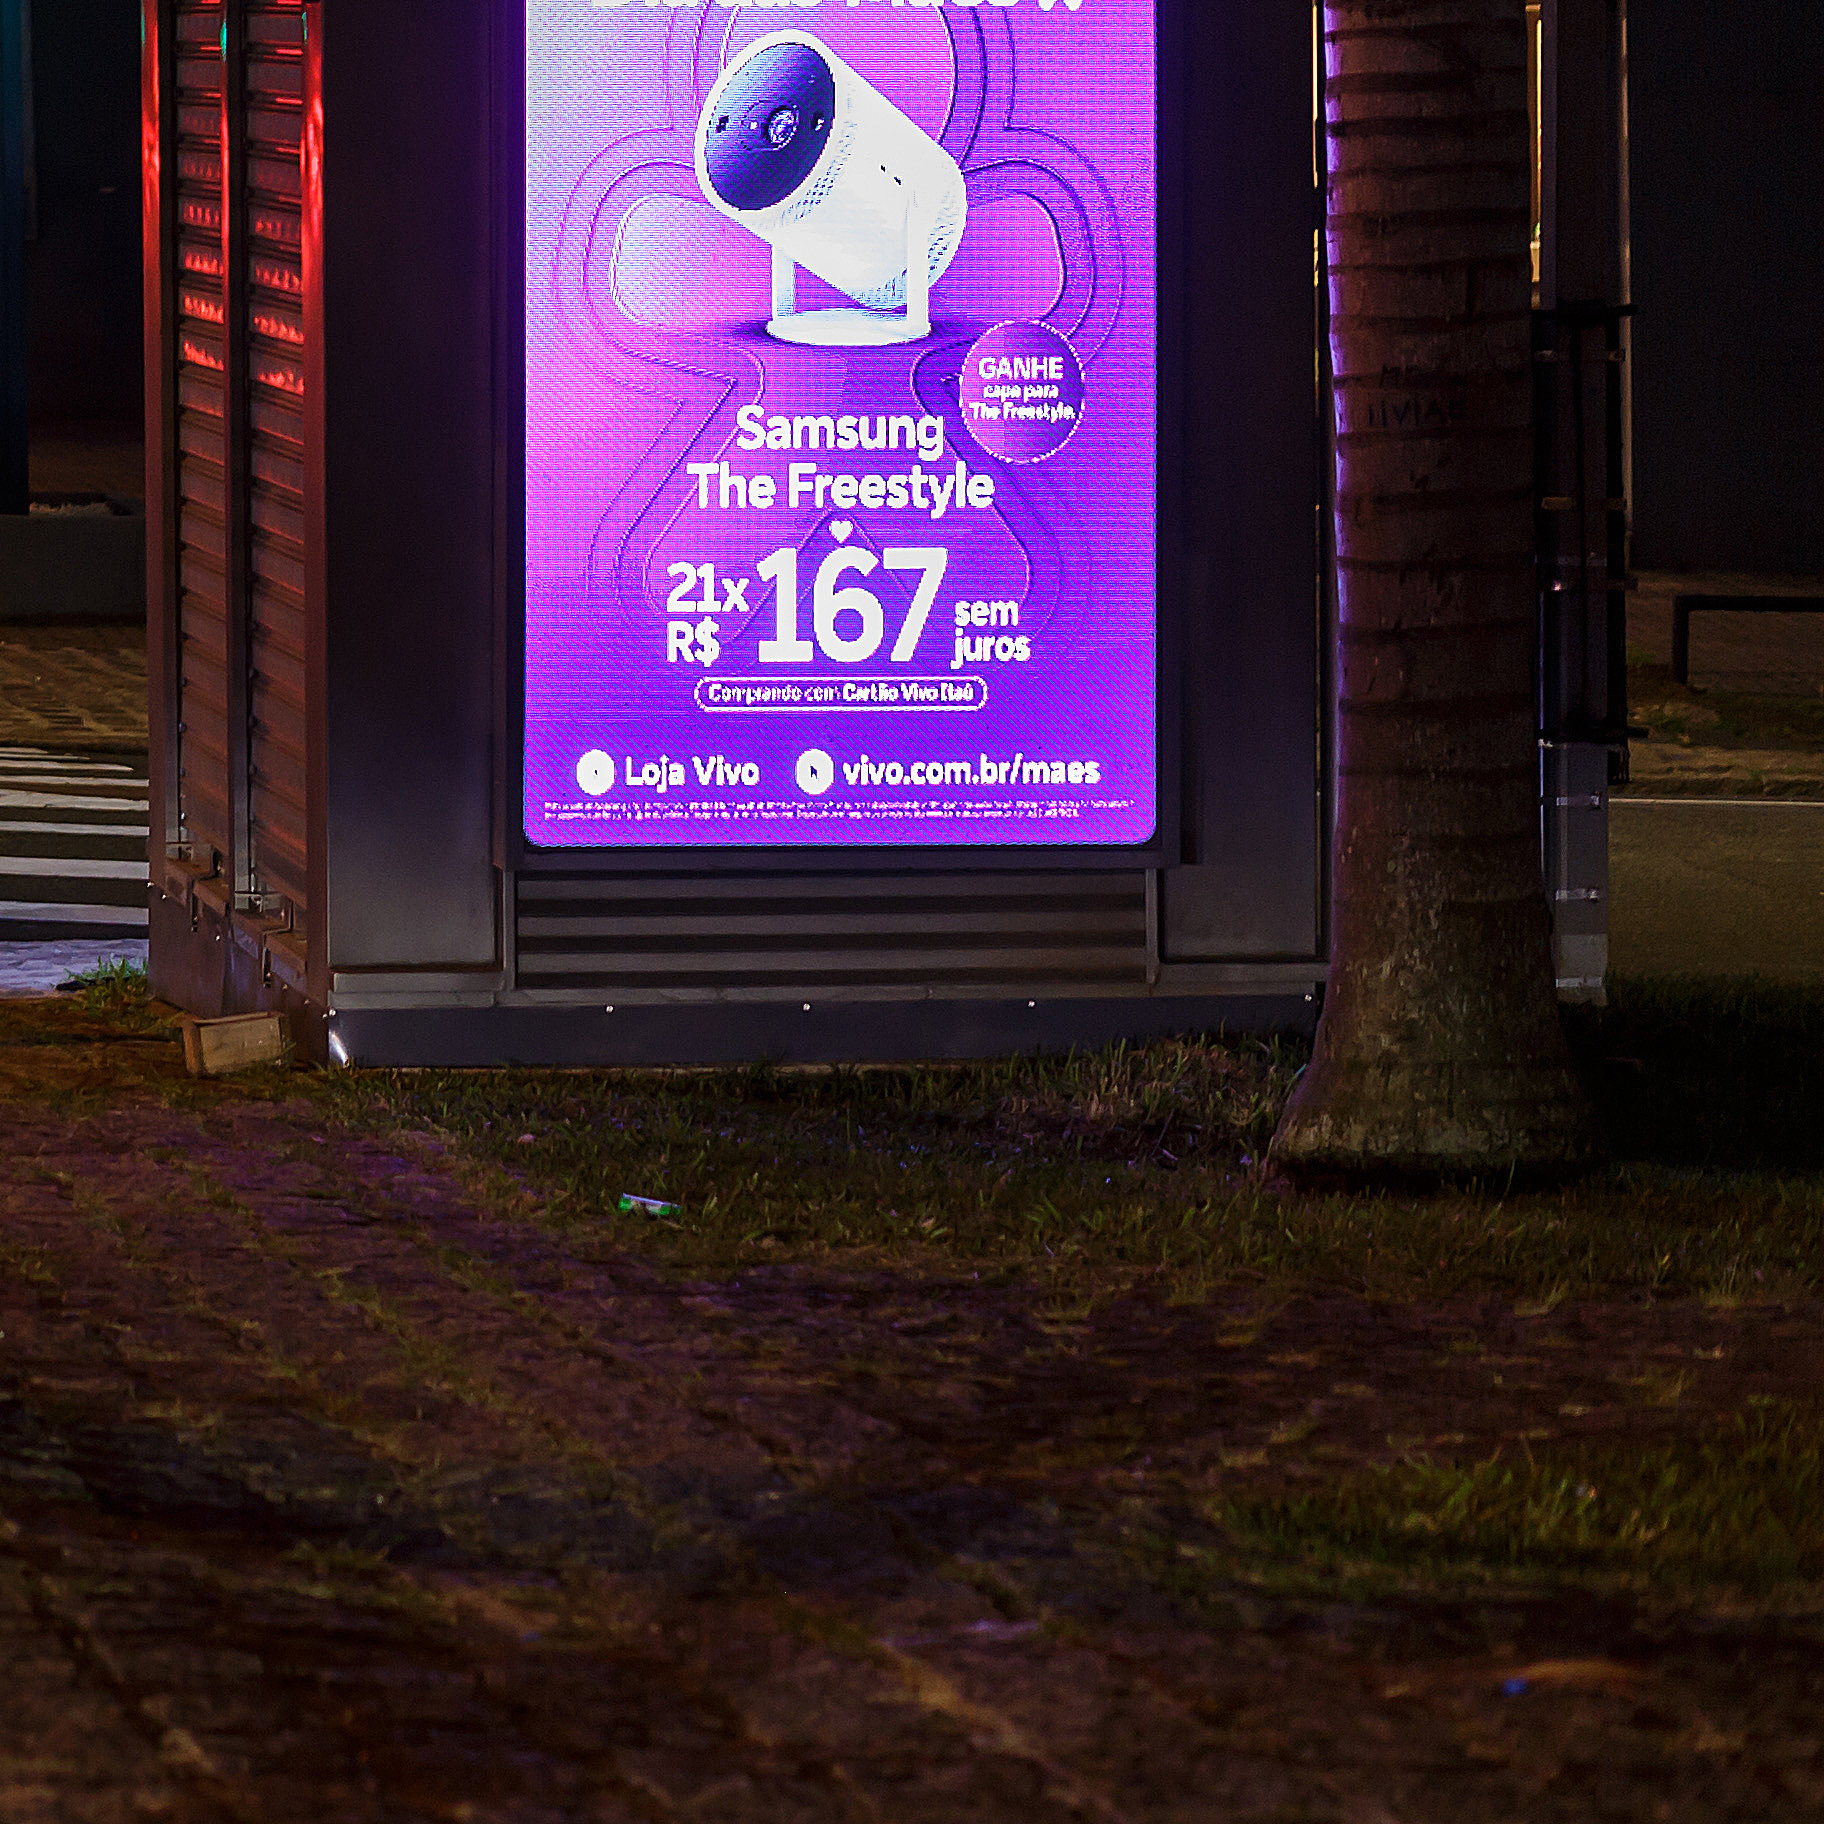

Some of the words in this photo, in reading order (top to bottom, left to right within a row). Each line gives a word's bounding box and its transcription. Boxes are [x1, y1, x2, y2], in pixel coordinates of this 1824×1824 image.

[978, 356, 1064, 380] GANHE
[983, 384, 1021, 403] capa
[1023, 384, 1059, 403] para
[968, 402, 1001, 420] The
[1003, 401, 1077, 424] Freestyle
[736, 405, 944, 460] Samsung
[688, 465, 777, 509] The
[789, 464, 995, 518] Freestyle
[666, 563, 749, 613] 21x
[756, 545, 949, 664] 167
[955, 598, 1019, 626] sem
[666, 617, 721, 667] R$
[950, 631, 1031, 668] juros
[708, 682, 803, 705] Comprando
[805, 685, 841, 702] com
[843, 681, 899, 702] Cartão
[901, 682, 939, 702] Vivo
[625, 755, 687, 793] Loja
[693, 755, 760, 786] Vivo
[842, 754, 1101, 786] vivo.com.br/maes
